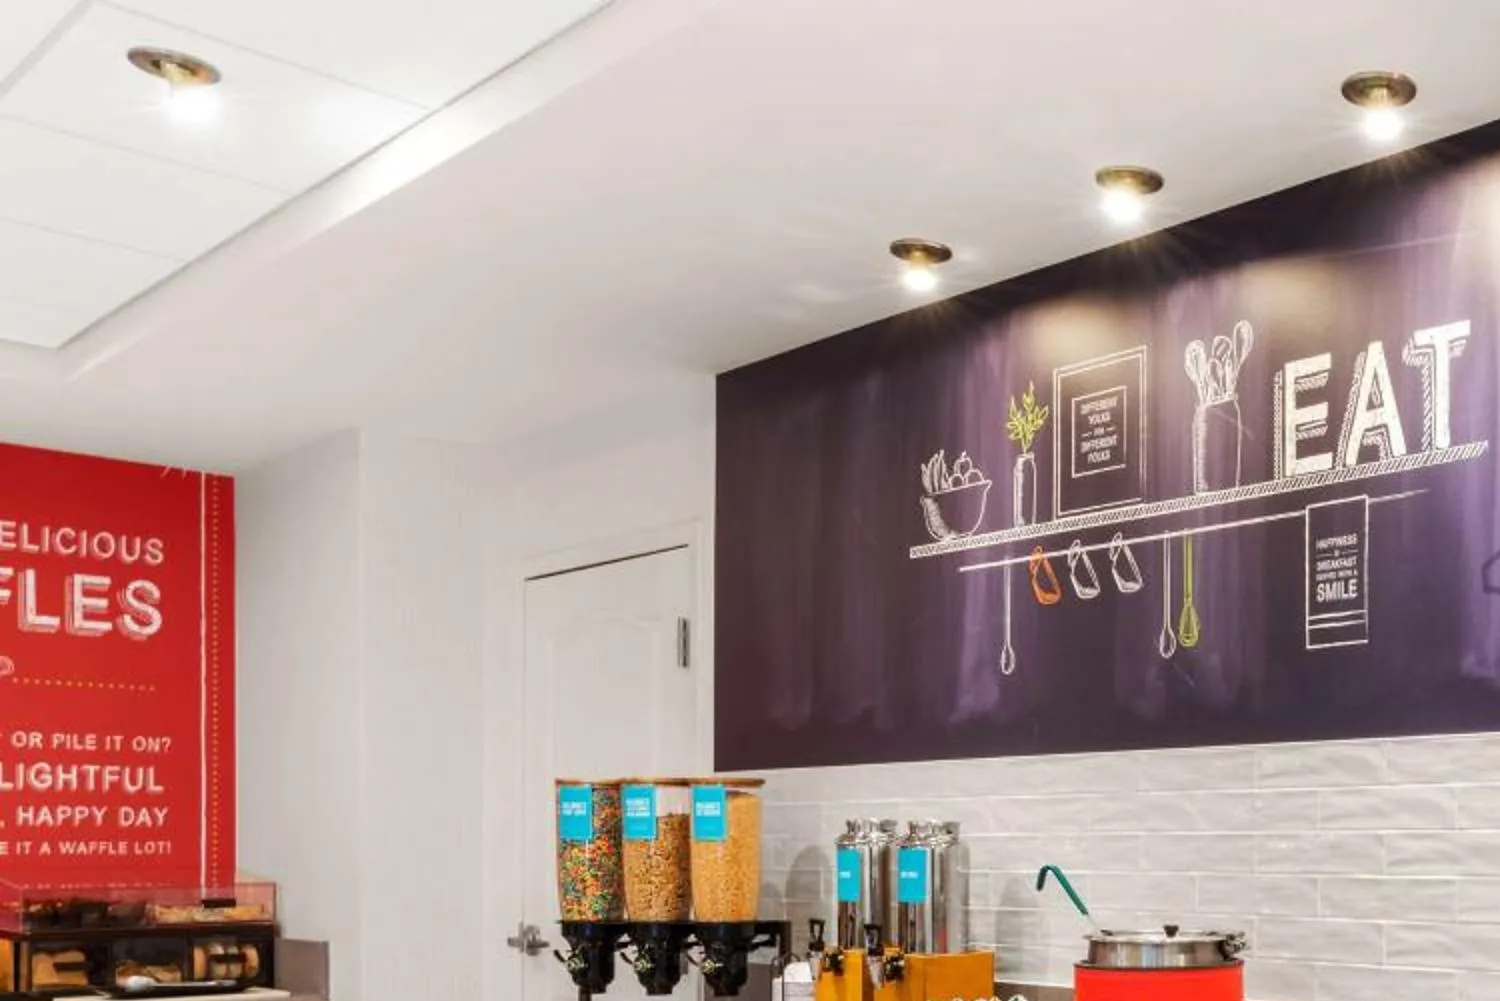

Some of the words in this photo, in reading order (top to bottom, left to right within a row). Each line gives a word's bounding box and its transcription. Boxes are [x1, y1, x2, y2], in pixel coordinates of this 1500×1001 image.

[1274, 319, 1471, 481] EAT
[1316, 578, 1358, 603] SMILE
[10, 730, 44, 749] OR
[52, 733, 97, 751] PILE
[105, 735, 124, 751] IT
[131, 735, 172, 753] ON?
[16, 804, 108, 828] HAPPY
[118, 805, 169, 828] DAY
[16, 841, 32, 855] IT
[39, 841, 51, 855] A
[58, 841, 129, 856] WAFFLE
[134, 841, 172, 856] LOT!
